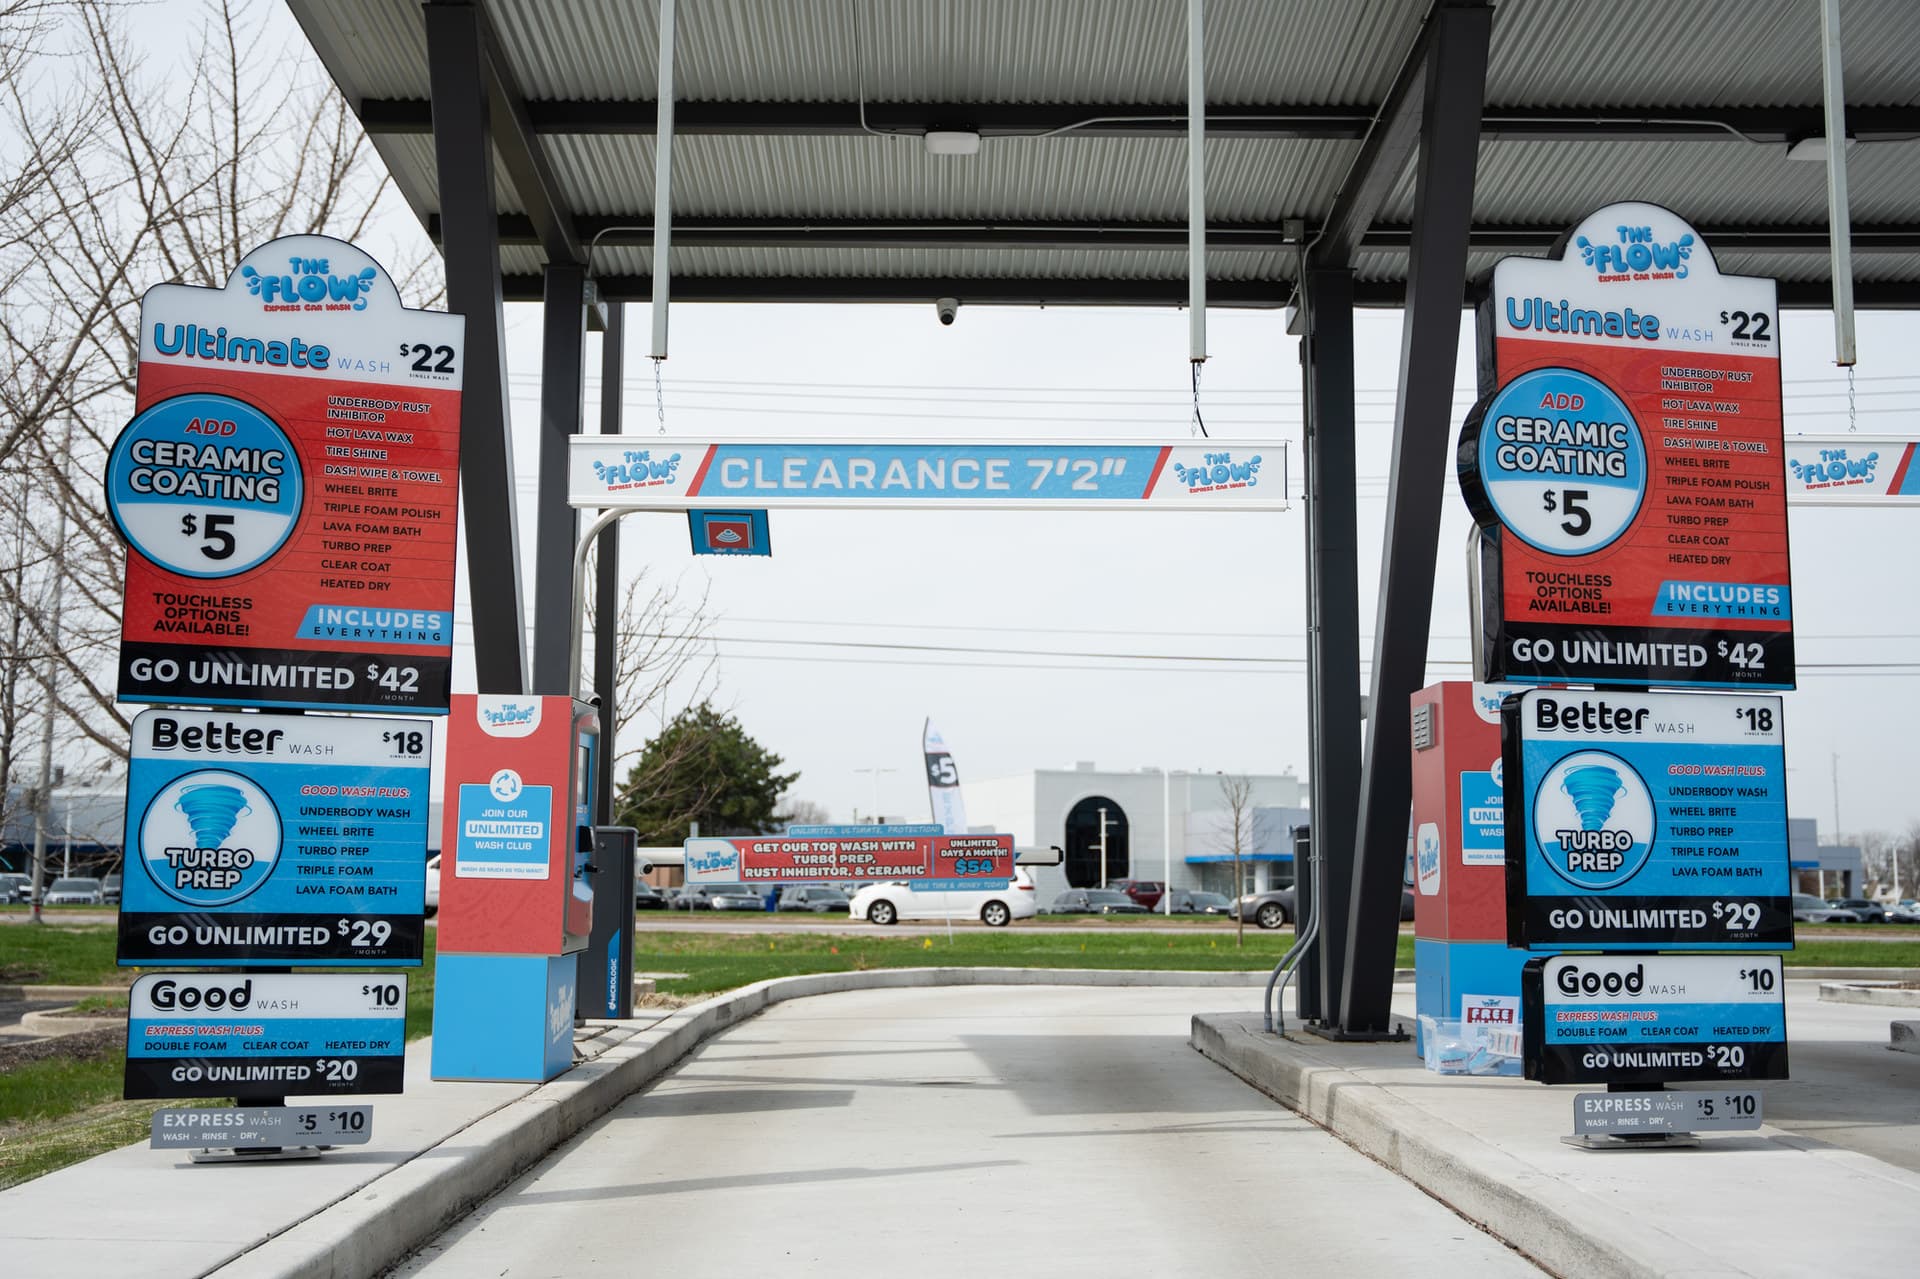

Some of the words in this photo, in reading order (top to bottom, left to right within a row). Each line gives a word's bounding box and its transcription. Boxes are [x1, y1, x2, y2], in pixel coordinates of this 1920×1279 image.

[1616, 225, 1652, 243] THE
[290, 257, 329, 275] THE
[1594, 242, 1680, 274] FLOW
[261, 274, 361, 303] FLOW
[325, 303, 351, 311] WASH
[1506, 297, 1660, 341] Ultimate
[1666, 328, 1713, 342] WASH
[1720, 311, 1771, 341] $22
[153, 322, 330, 371] Ultimate
[337, 357, 390, 374] WASH
[400, 343, 455, 374] $22
[328, 395, 400, 411] UNDERBODY
[402, 402, 431, 413] RUST
[327, 409, 385, 423] INHIBITOR
[184, 417, 237, 437] ADD
[326, 427, 350, 439] HOT
[353, 429, 383, 441] LAVA
[385, 431, 414, 444] WAX
[130, 439, 284, 475] CERAMIC
[326, 446, 349, 458] TIRE
[352, 448, 387, 461] SHINE
[624, 450, 650, 462] THE
[1204, 453, 1231, 465] THE
[1820, 449, 1847, 462] THE
[324, 464, 357, 477] DASH
[359, 467, 389, 479] WIPE
[391, 469, 399, 479] &
[402, 470, 443, 483] TOWEL
[606, 460, 670, 485] FLOW
[720, 457, 1010, 490] CLEARANCE
[1186, 461, 1251, 487] FLOW
[1802, 459, 1869, 483] FLOW
[129, 468, 280, 502] COATING
[324, 483, 363, 496] WHEEL
[367, 486, 398, 498] BRITE
[1189, 485, 1214, 493] EXPRESS
[323, 502, 361, 515] TRIPLE
[364, 504, 399, 517] FOAM
[402, 506, 441, 519] POLISH
[1543, 489, 1592, 537] $5
[181, 513, 236, 560] $5
[323, 521, 351, 533] LAVA
[354, 523, 389, 535] FOAM
[392, 525, 422, 537] BATH
[322, 540, 361, 552] TURBO
[364, 542, 392, 554] PREP
[321, 559, 357, 571] CLEAR
[360, 561, 391, 573] COAT
[320, 578, 365, 590] HEATED
[367, 580, 391, 592] DRY
[152, 592, 253, 609] TOUCHLESS
[164, 607, 240, 623] OPTIONS
[318, 608, 441, 629] INCLUDES
[153, 620, 250, 637] AVAILABLE!
[314, 626, 441, 641] EVERYTHING
[1512, 638, 1554, 662] GO
[1562, 640, 1707, 667] UNLIMITED
[1718, 640, 1765, 669] $42
[129, 658, 179, 683] GO
[188, 661, 355, 690] UNLIMITED
[367, 663, 419, 692] $42
[1536, 699, 1649, 732] Better
[1655, 723, 1695, 734] WASH
[1736, 708, 1773, 732] $18
[151, 718, 284, 753] Better
[289, 744, 334, 756] WASH
[382, 731, 424, 755] $18
[931, 757, 956, 784] $5
[301, 785, 338, 796] GOOD
[340, 786, 377, 797] WASH
[378, 787, 410, 799] PLUS:
[1669, 787, 1734, 797] UNDERBODY
[1737, 788, 1768, 797] WASH
[481, 808, 504, 819] JOIN
[507, 809, 528, 819] OUR
[1669, 807, 1705, 817] WHEEL
[1708, 807, 1736, 817] BRITE
[469, 823, 540, 836] UNLIMITED
[475, 840, 504, 851] WASH
[506, 841, 532, 851] CLUB
[753, 843, 779, 853] GET
[781, 842, 809, 852] OUR
[811, 842, 837, 851] TOP
[840, 841, 880, 851] WASH
[882, 841, 916, 850] WITH
[950, 839, 998, 848] UNLIMITED
[1671, 847, 1705, 857] TRIPLE
[1708, 847, 1739, 857] FOAM
[165, 847, 255, 870] TURBO
[793, 855, 837, 864] TURBO
[839, 854, 876, 865] PREP,
[941, 849, 962, 857] DAYS
[963, 849, 972, 857] A
[973, 849, 1008, 857] MONTH!
[745, 868, 778, 878] RUST
[781, 867, 852, 878] INHIBITOR,
[854, 866, 864, 876] &
[867, 865, 925, 876] CERAMIC
[955, 858, 993, 874] $54
[175, 868, 241, 890] PREP
[1550, 910, 1583, 929] GO
[1589, 909, 1707, 929] UNLIMITED
[1712, 901, 1761, 930] $29
[1557, 963, 1643, 996] Good
[1649, 984, 1686, 995] WASH
[1740, 968, 1774, 991] $10
[150, 979, 252, 1010] Good
[256, 1000, 299, 1010] WASH
[362, 984, 400, 1006] $10
[1471, 1008, 1509, 1019] FREE
[1557, 1027, 1595, 1037] DOUBLE
[1599, 1027, 1627, 1037] FOAM
[1641, 1026, 1672, 1036] CLEAR
[1674, 1026, 1699, 1036] COAT
[1713, 1026, 1750, 1036] HEATED
[1753, 1026, 1771, 1035] DRY
[163, 1113, 245, 1127] EXPRESS
[250, 1116, 282, 1126] WASH
[298, 1114, 317, 1131] $5
[329, 1111, 364, 1131] $10
[162, 1132, 190, 1141] WASH
[202, 1132, 228, 1141] RINSE
[240, 1131, 258, 1140] DRY
